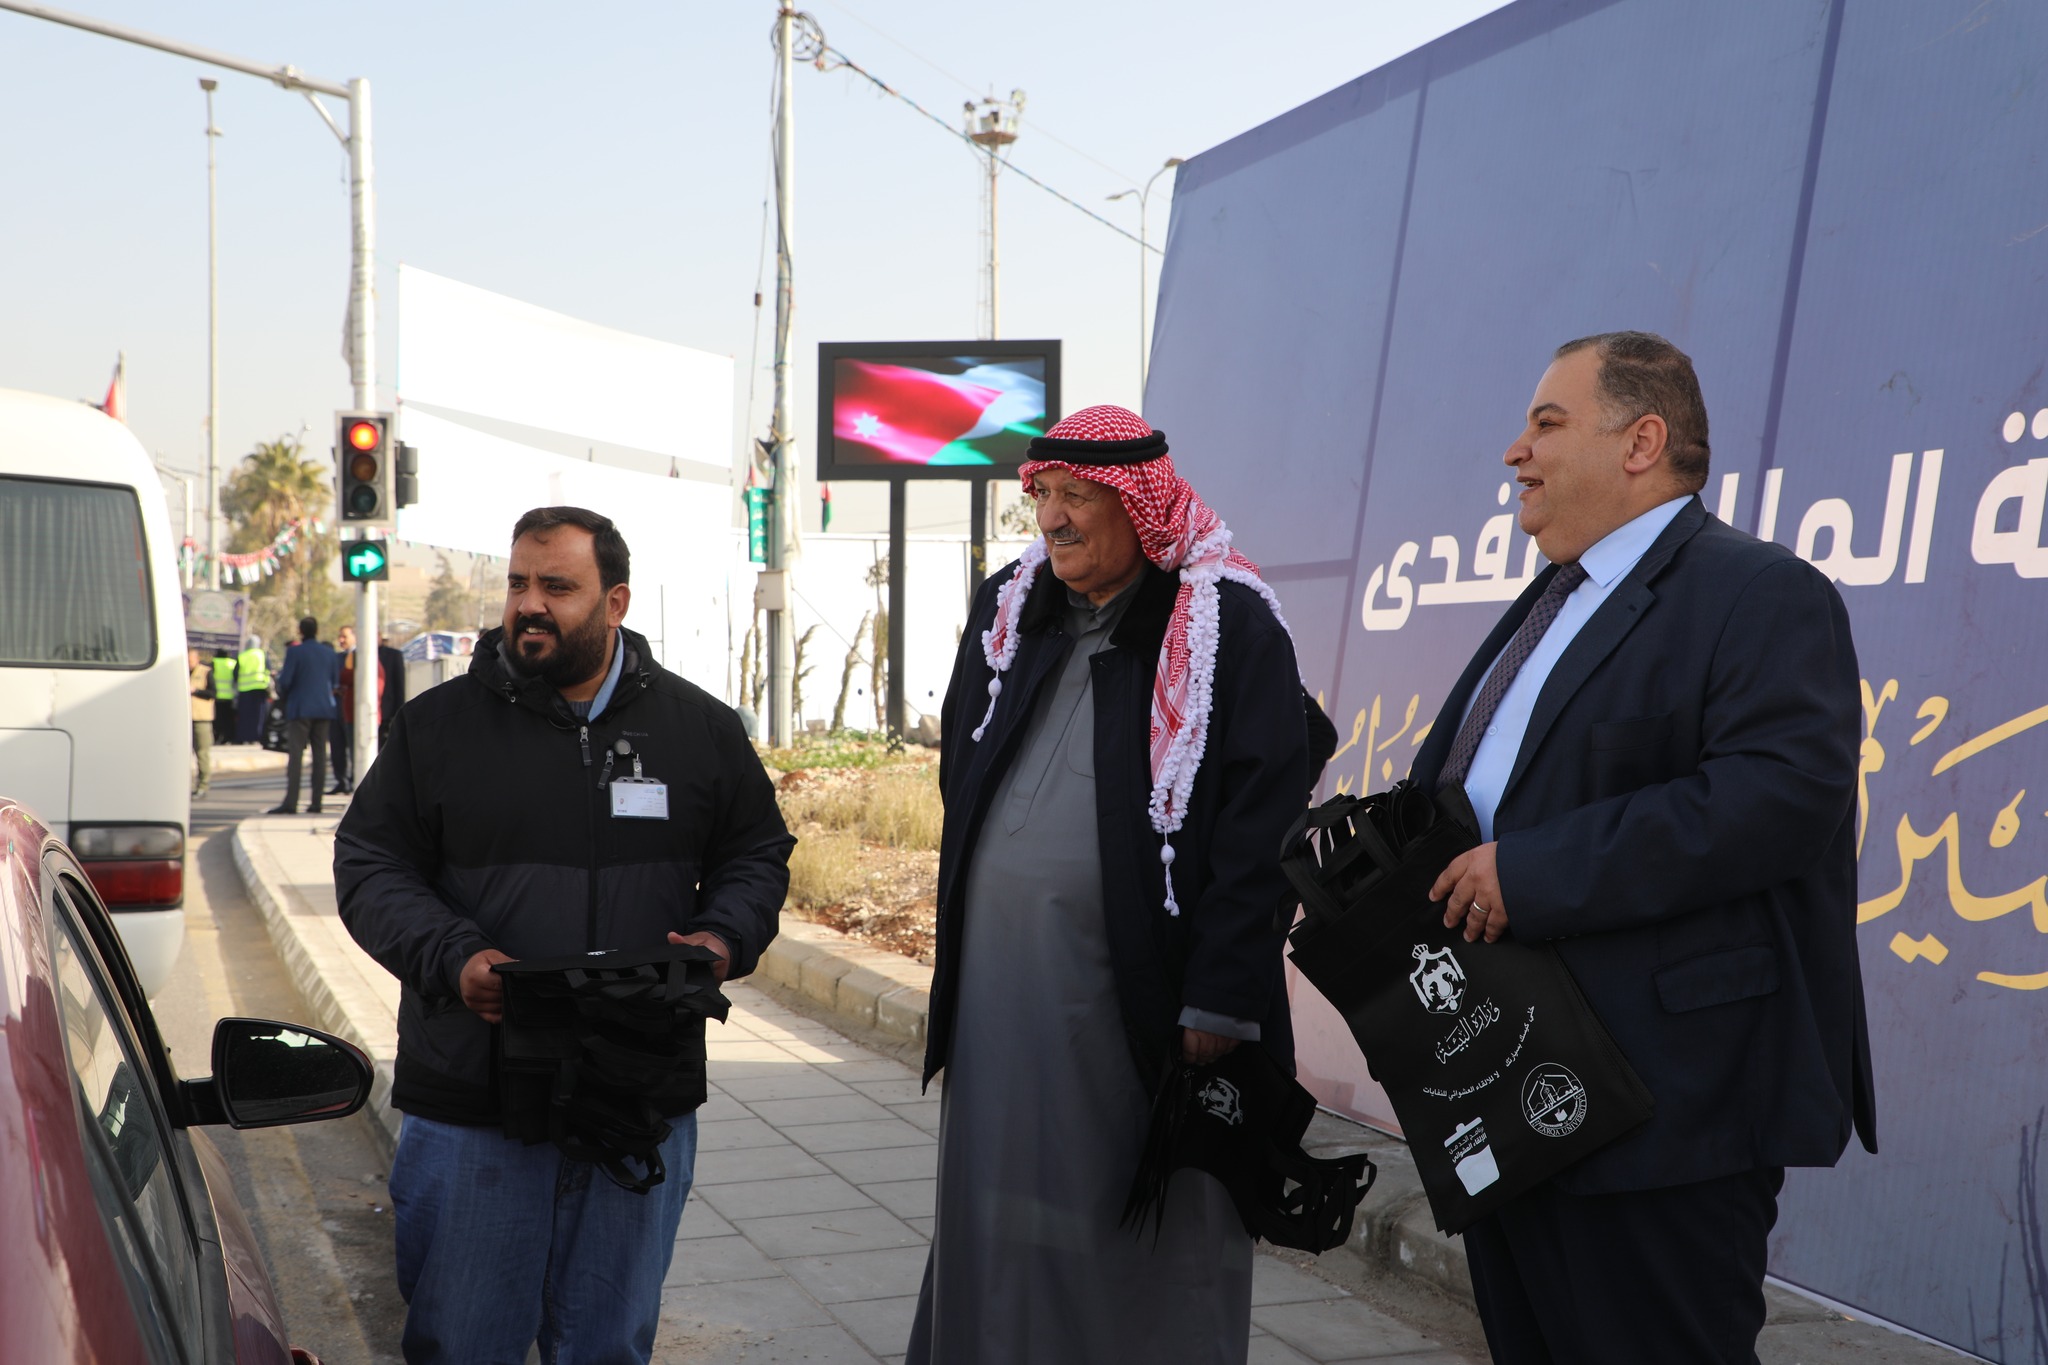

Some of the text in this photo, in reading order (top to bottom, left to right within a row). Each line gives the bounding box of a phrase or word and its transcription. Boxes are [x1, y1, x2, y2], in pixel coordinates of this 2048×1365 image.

[1717, 448, 1944, 587] المل
[1505, 1043, 1523, 1067] بسيارتك
[1493, 1070, 1500, 1079] لا
[1422, 1087, 1448, 1097] للنفايات
[1448, 1085, 1476, 1101] العشوائي
[1536, 1122, 1560, 1136] ZARQA
[1561, 1097, 1587, 1135] UNIVERSITY
